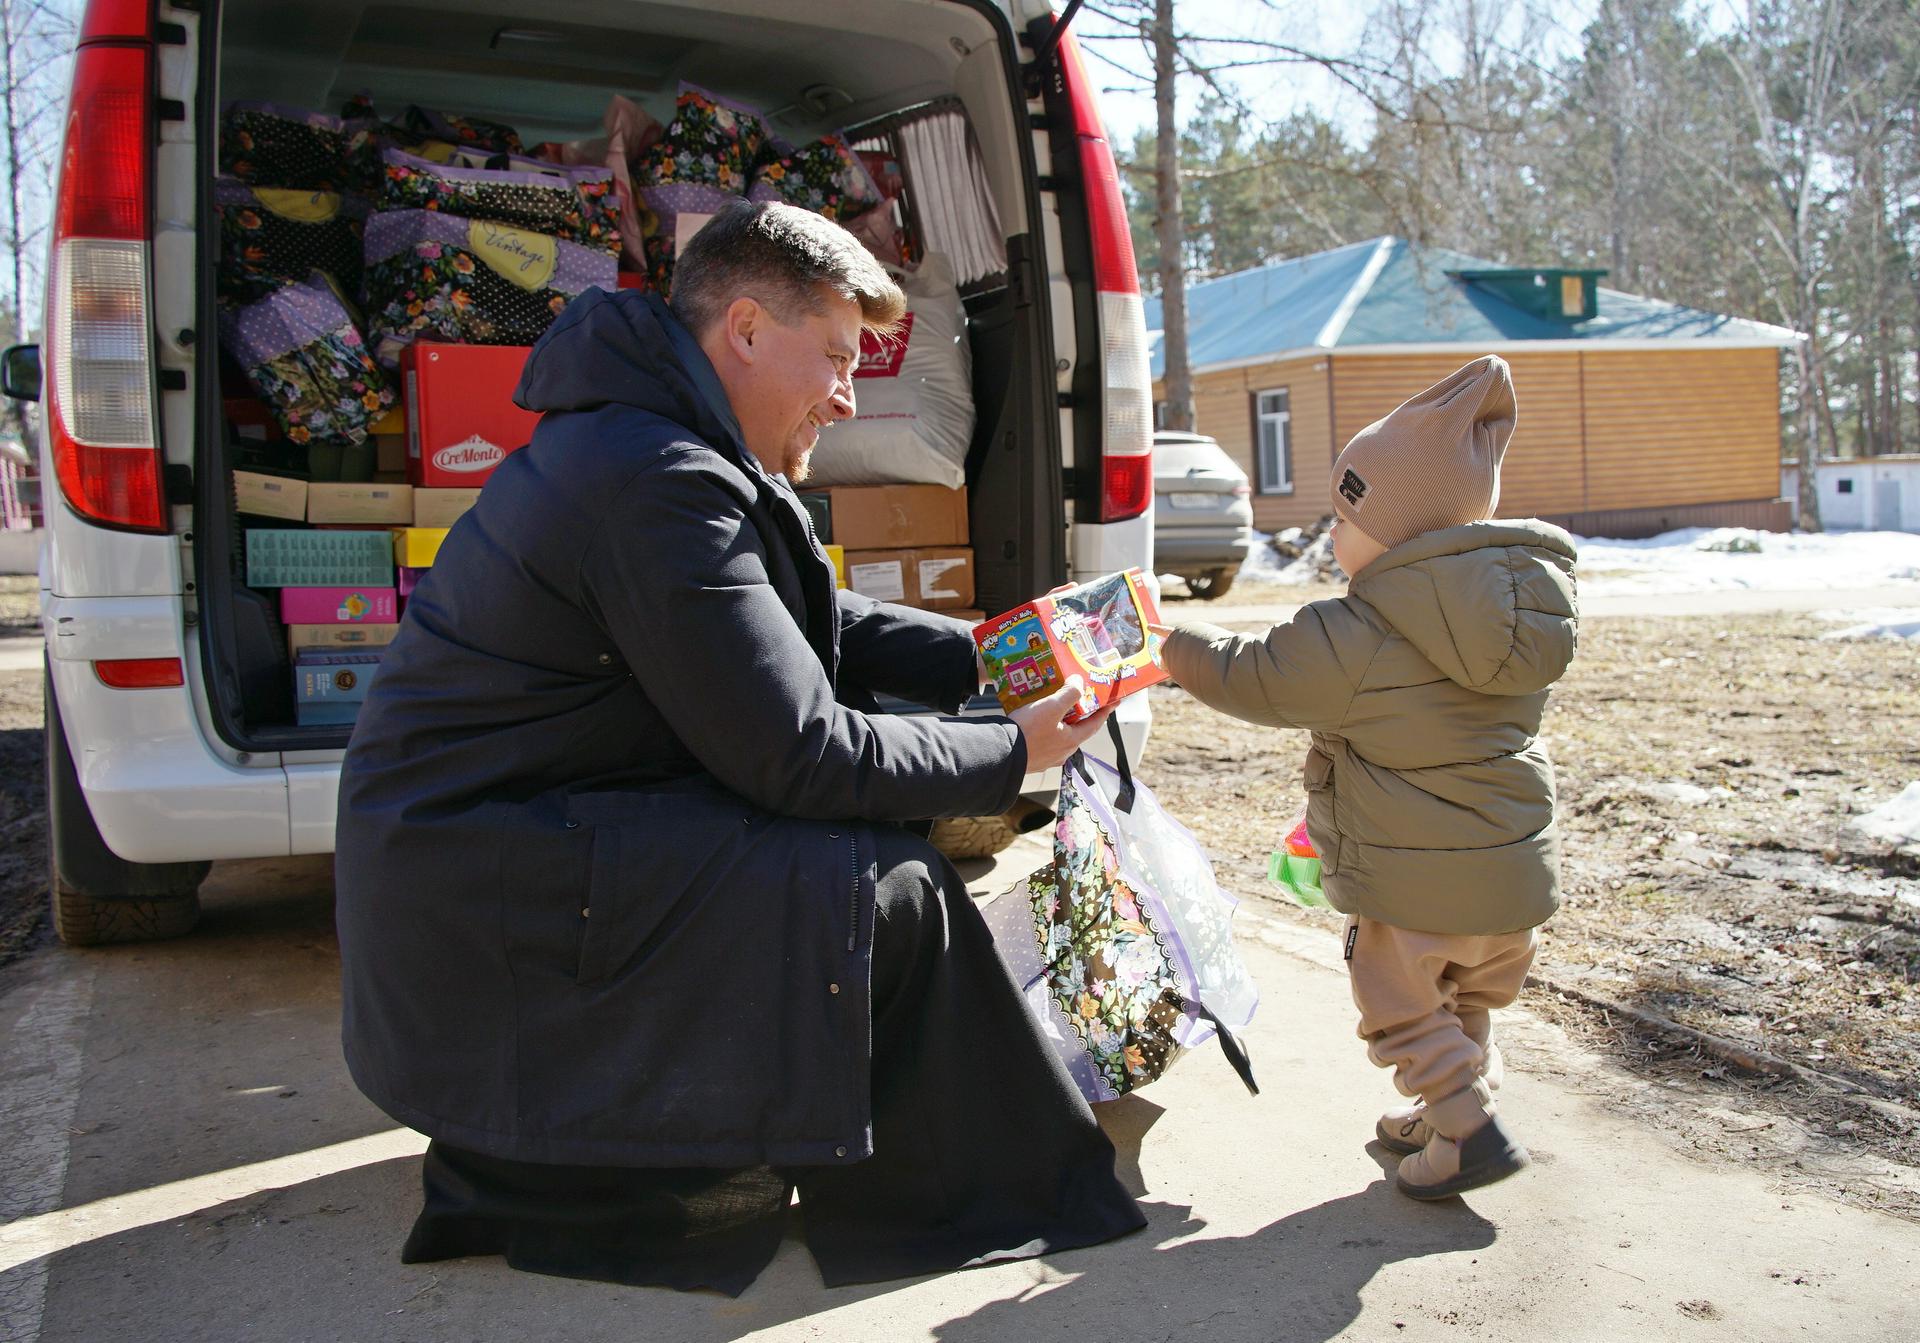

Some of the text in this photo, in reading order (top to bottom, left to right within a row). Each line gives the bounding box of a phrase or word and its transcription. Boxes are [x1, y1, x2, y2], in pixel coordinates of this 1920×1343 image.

[482, 221, 545, 271] Vintage
[860, 343, 896, 364] edi
[440, 447, 501, 466] CreMonte
